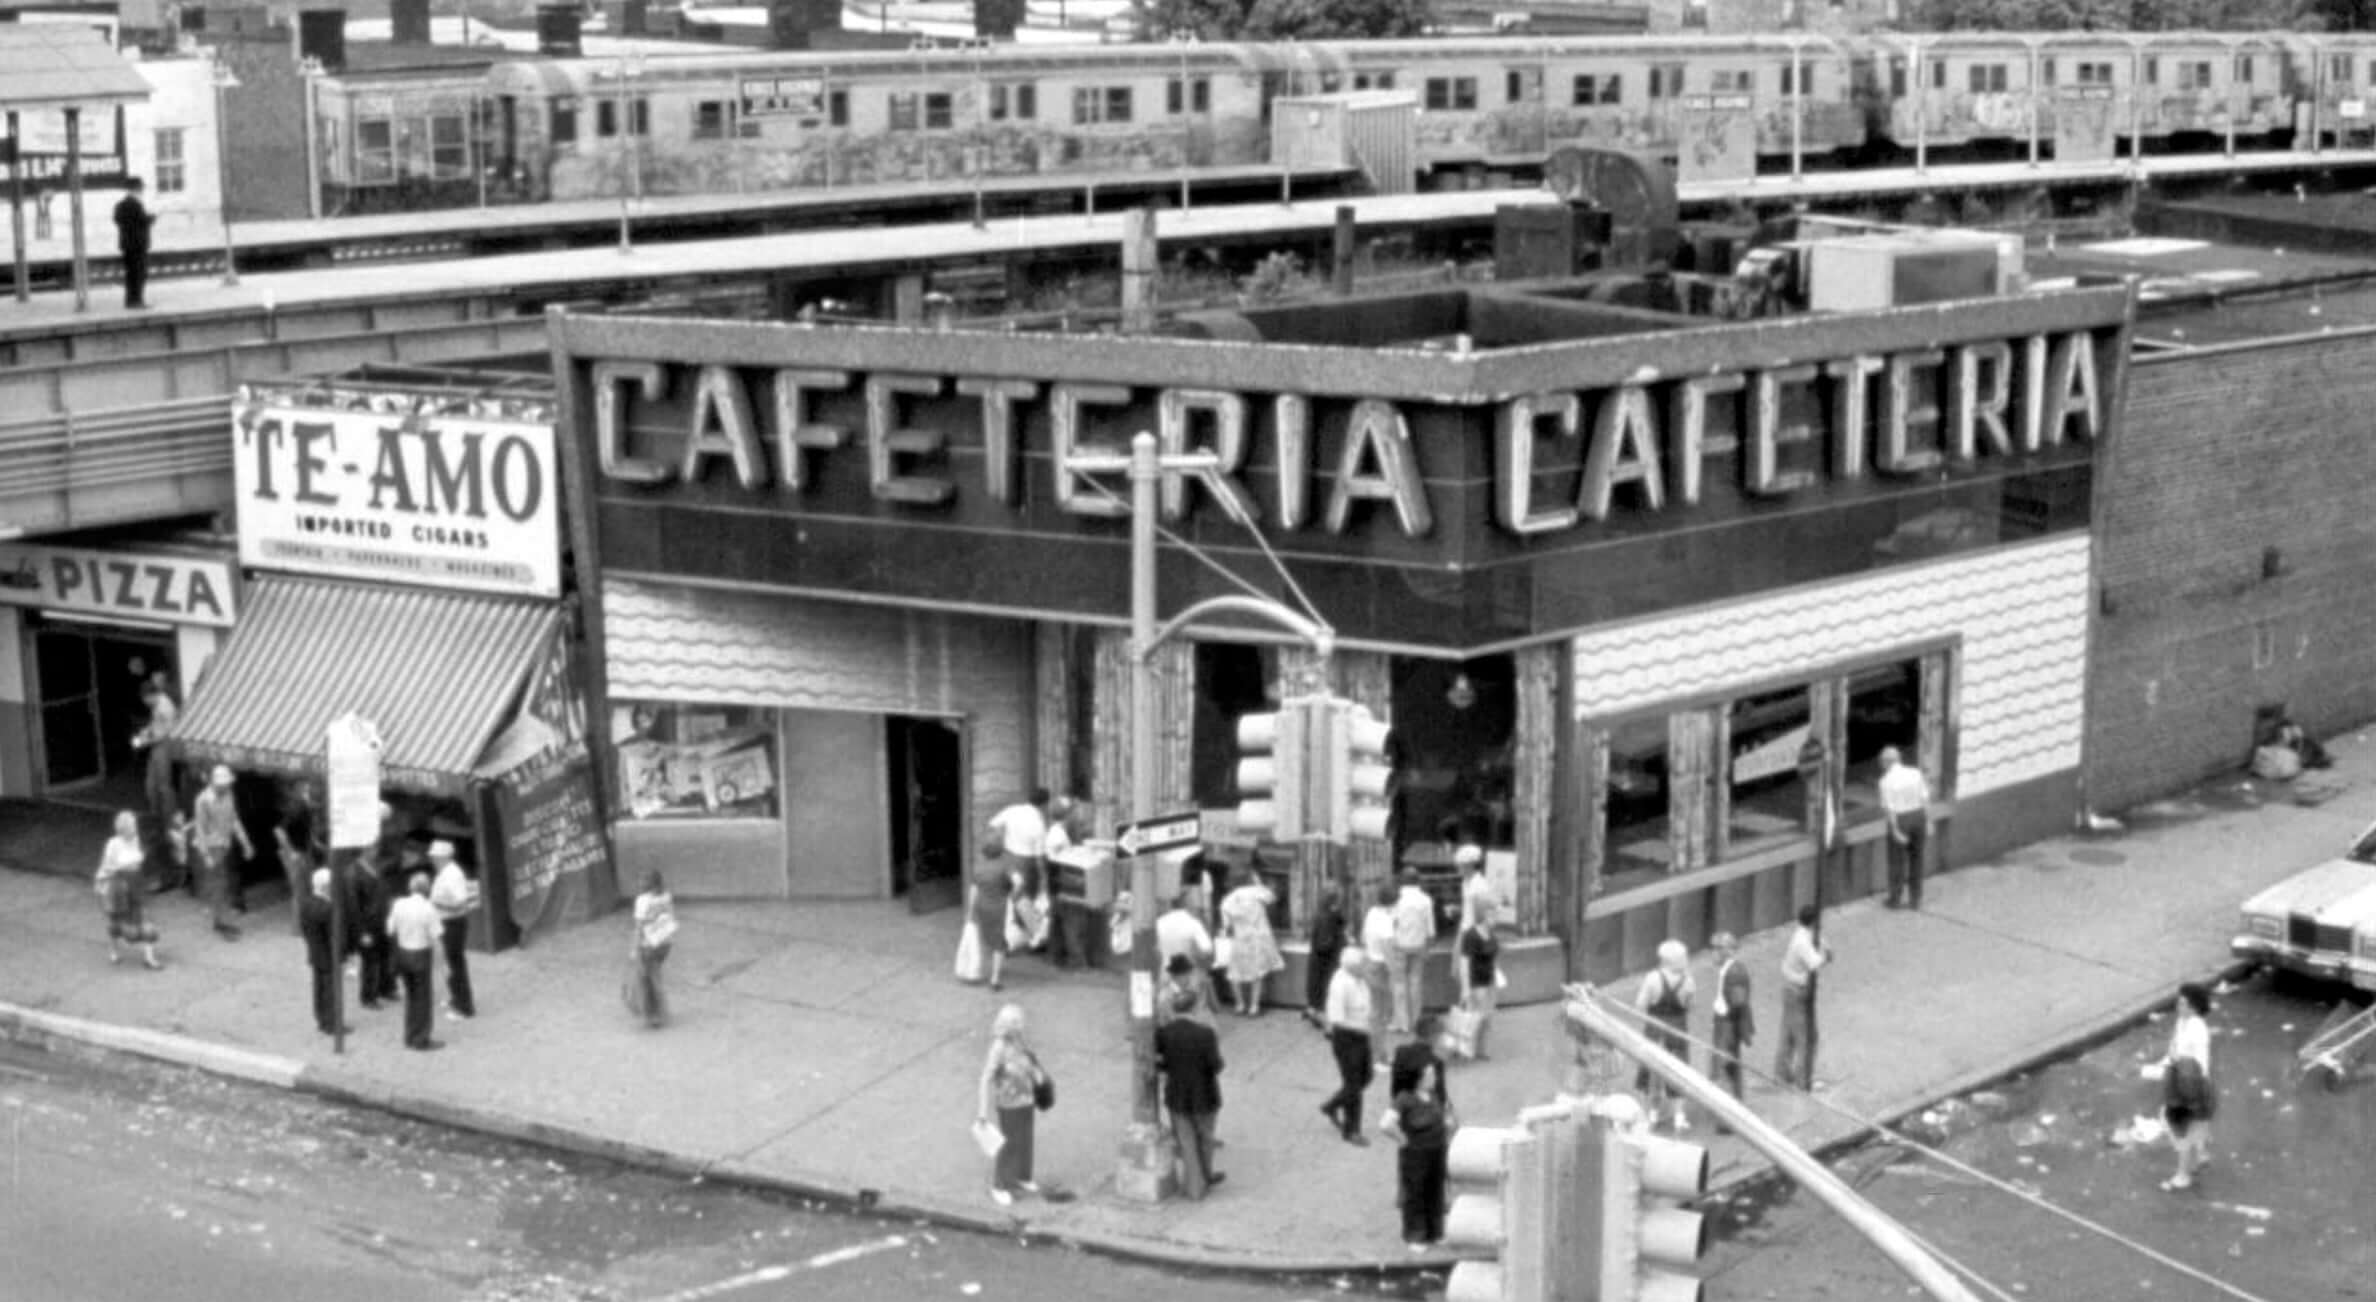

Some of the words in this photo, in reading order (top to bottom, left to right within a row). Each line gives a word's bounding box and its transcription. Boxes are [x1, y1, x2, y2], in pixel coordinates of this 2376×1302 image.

[242, 414, 543, 523] TE-AMO
[591, 360, 1434, 538] CAFETERIA
[1497, 331, 2101, 533] CAFETERIA
[51, 556, 223, 616] PIZZA
[296, 515, 392, 539] IMPORTED
[412, 525, 489, 548] CIGARS
